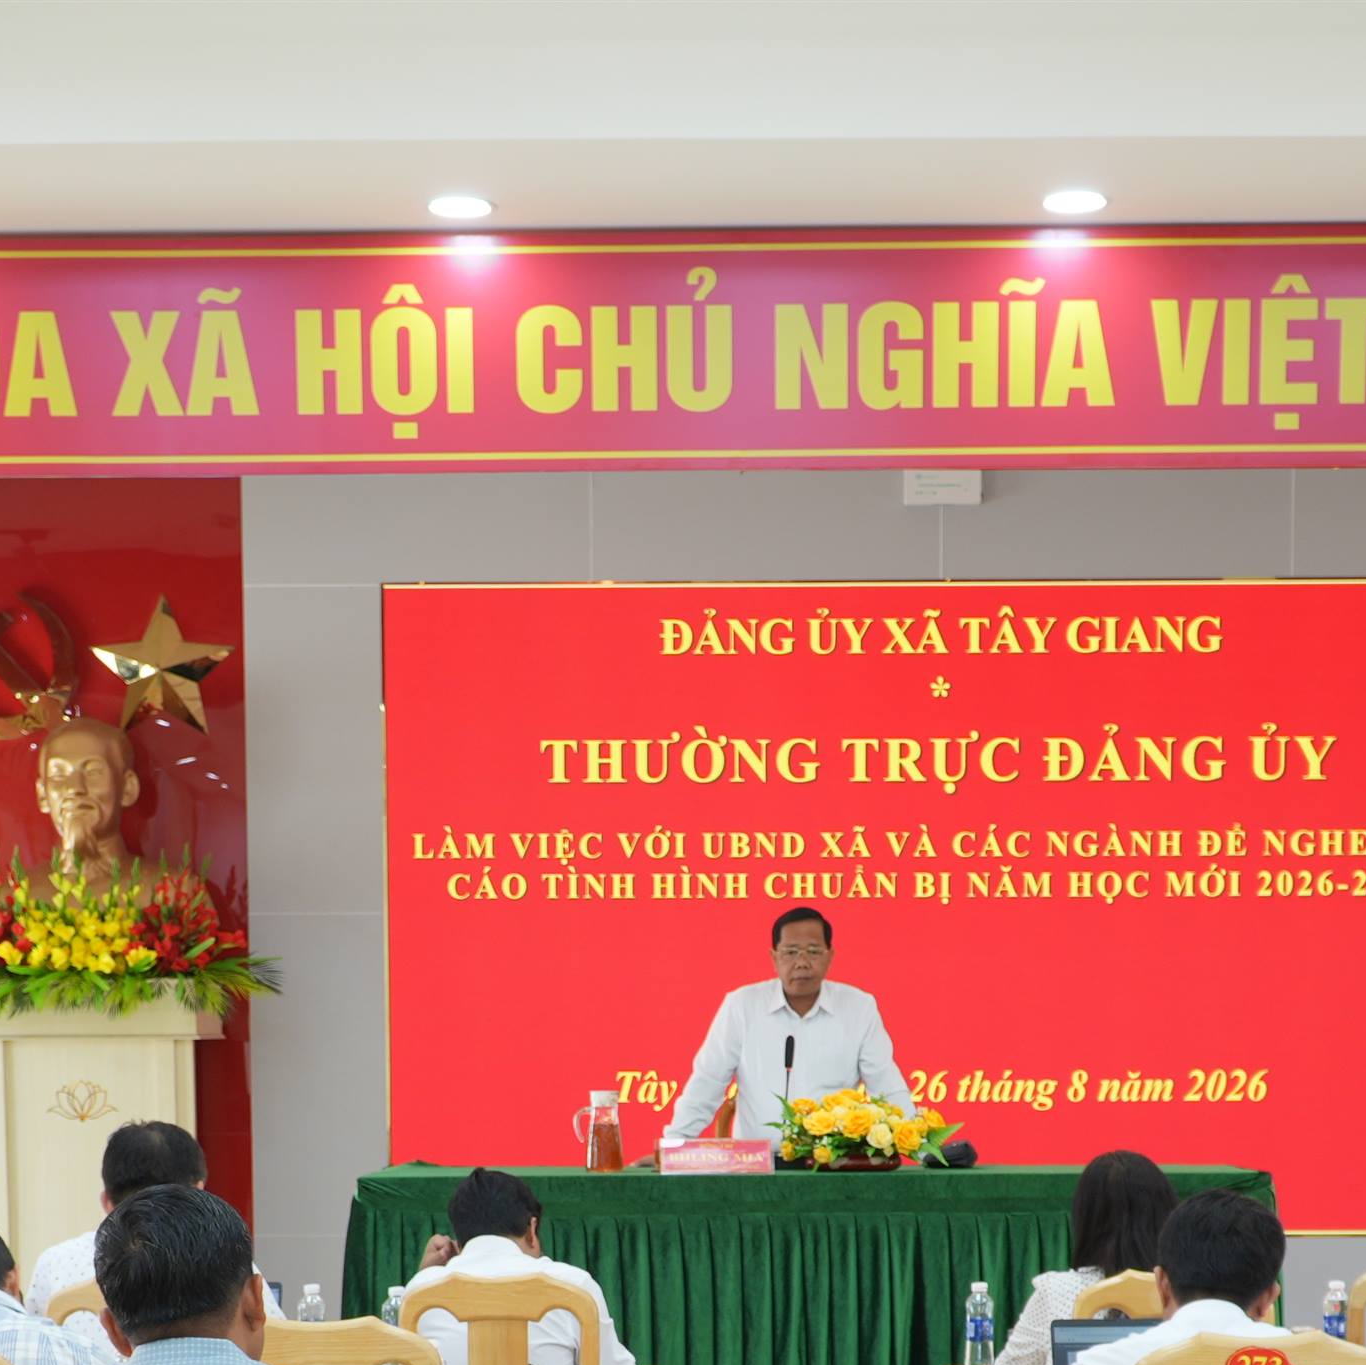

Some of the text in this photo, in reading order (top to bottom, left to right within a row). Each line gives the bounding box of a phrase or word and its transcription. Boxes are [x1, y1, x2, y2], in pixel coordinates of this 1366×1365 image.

[109, 286, 261, 418] XÃ
[294, 283, 475, 440] HỘI
[514, 265, 733, 413] CHỦ
[773, 277, 1116, 410] NGHĨA
[658, 605, 1223, 656] ĐẢNG ỦY XÃ TÂY GIANG
[539, 722, 1337, 795] THƯỜNG TRỰC ĐẢNG ỦY
[412, 825, 496, 860] LÀM
[509, 829, 604, 866] VIỆC
[616, 825, 686, 860] VỚI
[702, 832, 806, 860] UBND
[820, 825, 872, 858] XÃ
[885, 823, 938, 858] VÀ
[951, 823, 1031, 858] CÁC
[1045, 823, 1183, 858] NGÀNH
[1197, 821, 1248, 857] ĐỂ
[446, 866, 528, 900] CÁO
[540, 866, 637, 900] TÌNH
[651, 866, 749, 900] HÌNH
[763, 864, 898, 900] CHUẨN
[913, 872, 952, 905] BỊ
[966, 864, 1053, 899] NĂM
[1068, 871, 1150, 905] HỌC
[1165, 863, 1241, 898] MỚI
[616, 1069, 678, 1112] Tây
[909, 1070, 948, 1104] 26
[956, 1069, 1058, 1112] tháng
[1066, 1069, 1090, 1104] 8
[1097, 1071, 1175, 1104] năm
[1183, 1068, 1269, 1103] 2026
